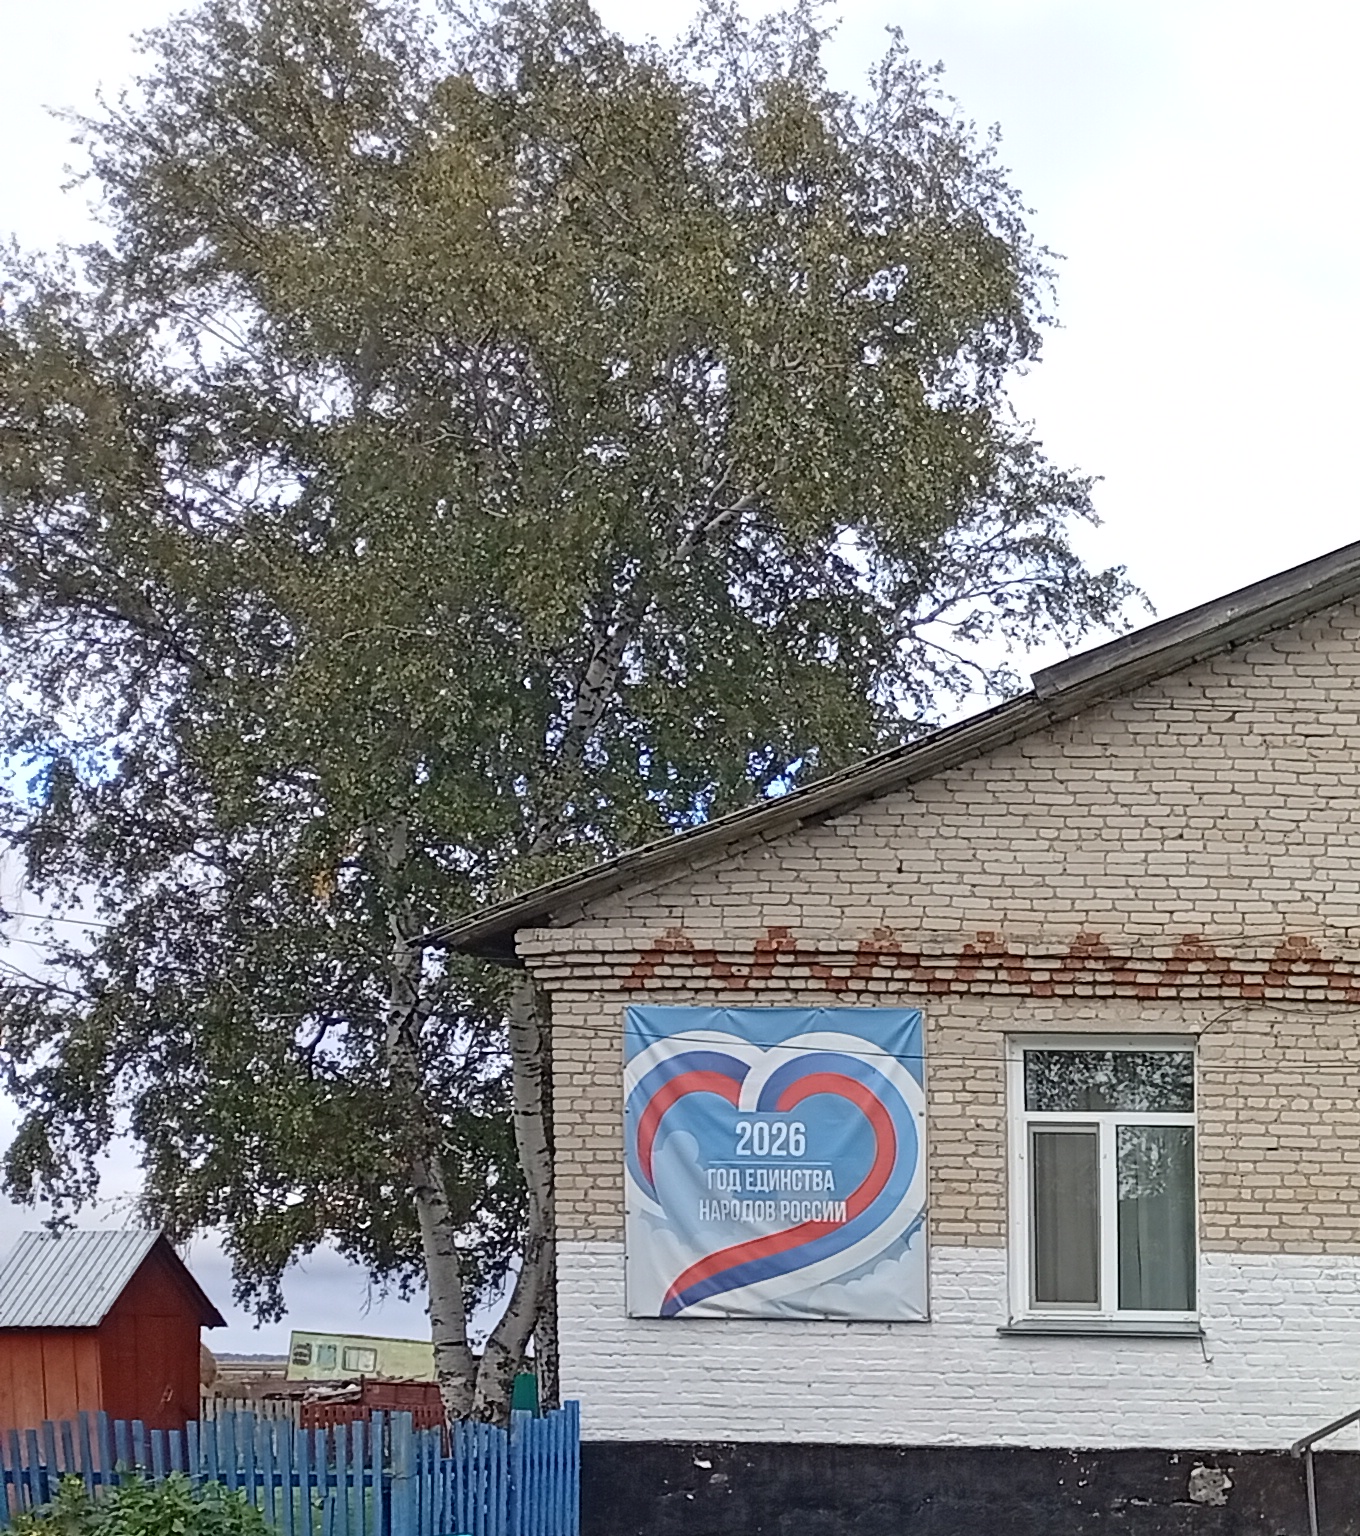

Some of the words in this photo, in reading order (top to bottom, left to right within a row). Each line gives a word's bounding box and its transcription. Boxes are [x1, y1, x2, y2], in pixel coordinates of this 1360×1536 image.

[736, 1121, 806, 1156] 2026
[707, 1169, 741, 1193] ГОД
[745, 1169, 835, 1193] ЕДИНСТВА
[699, 1199, 775, 1224] НАРОДОВ
[780, 1201, 847, 1223] РОССИИ
